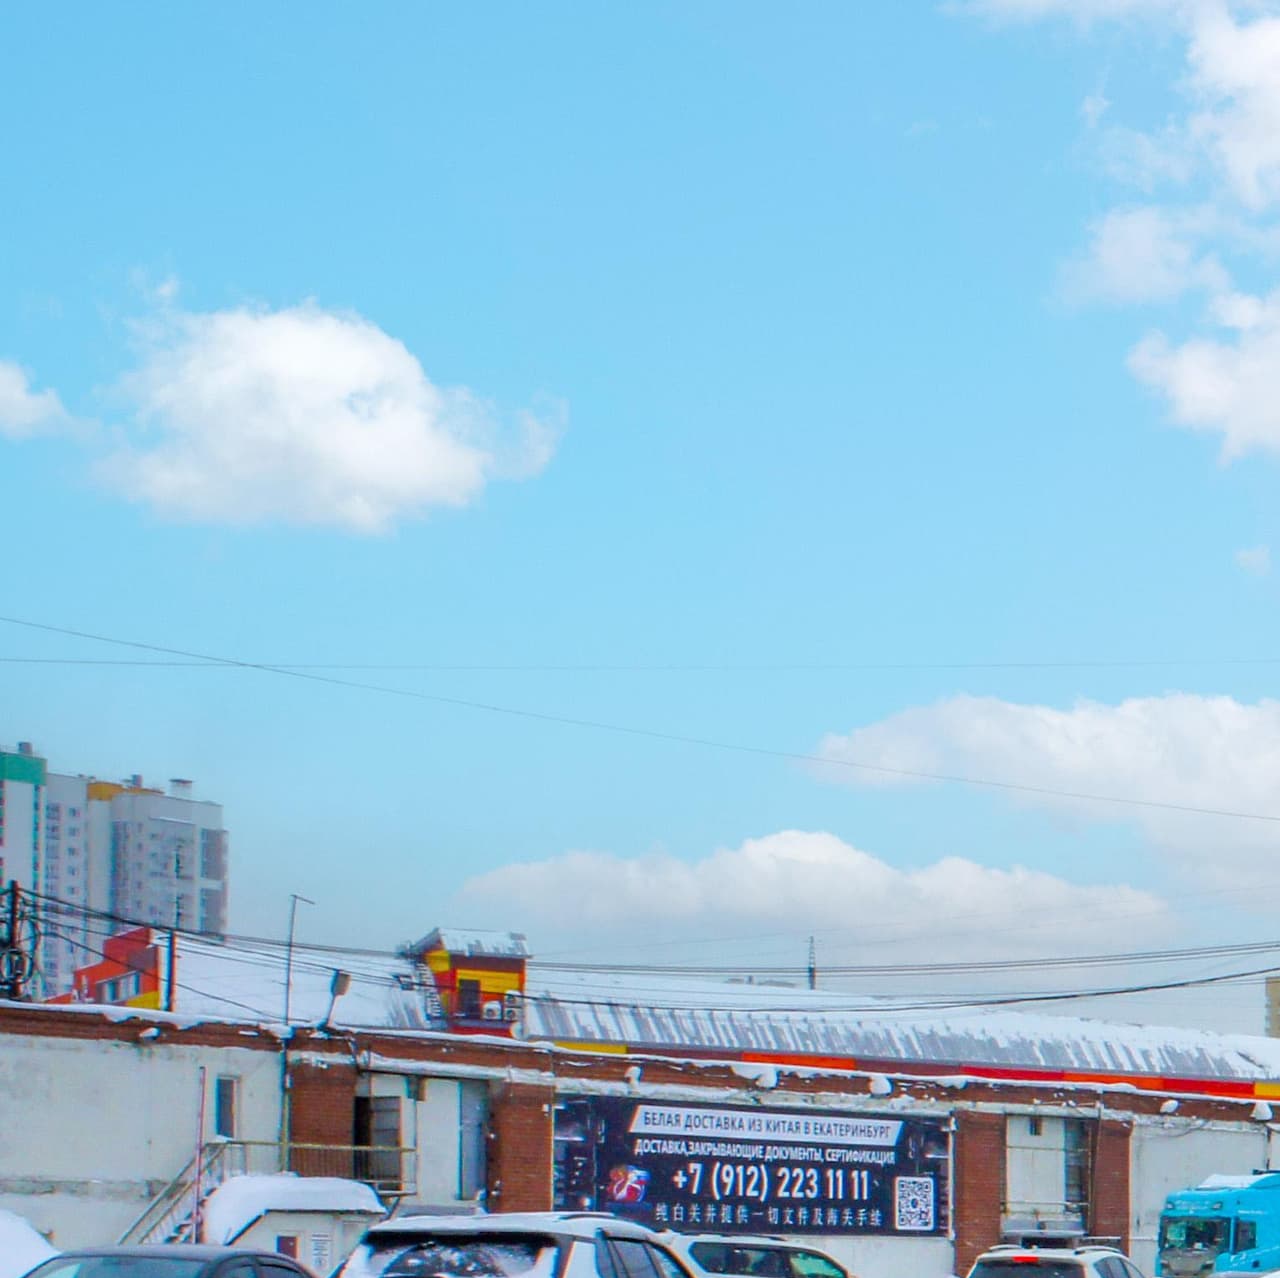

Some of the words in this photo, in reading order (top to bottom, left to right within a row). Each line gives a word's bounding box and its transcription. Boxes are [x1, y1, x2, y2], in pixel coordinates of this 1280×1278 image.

[643, 1111, 681, 1126] БЕЛАЯ
[684, 1114, 745, 1130] ДОСТАВКА
[748, 1117, 762, 1131] ИЗ
[765, 1120, 801, 1133] КИТАЯ
[804, 1122, 811, 1135] В
[813, 1122, 891, 1139] ЕКАТЕРИНБУРГ
[825, 1148, 896, 1167] СЕРТИФИКАЦИЯ
[672, 1162, 703, 1195] +7
[711, 1160, 769, 1202] (912)
[776, 1166, 819, 1198] 223
[825, 1168, 844, 1200] 11
[850, 1169, 870, 1201] 11
